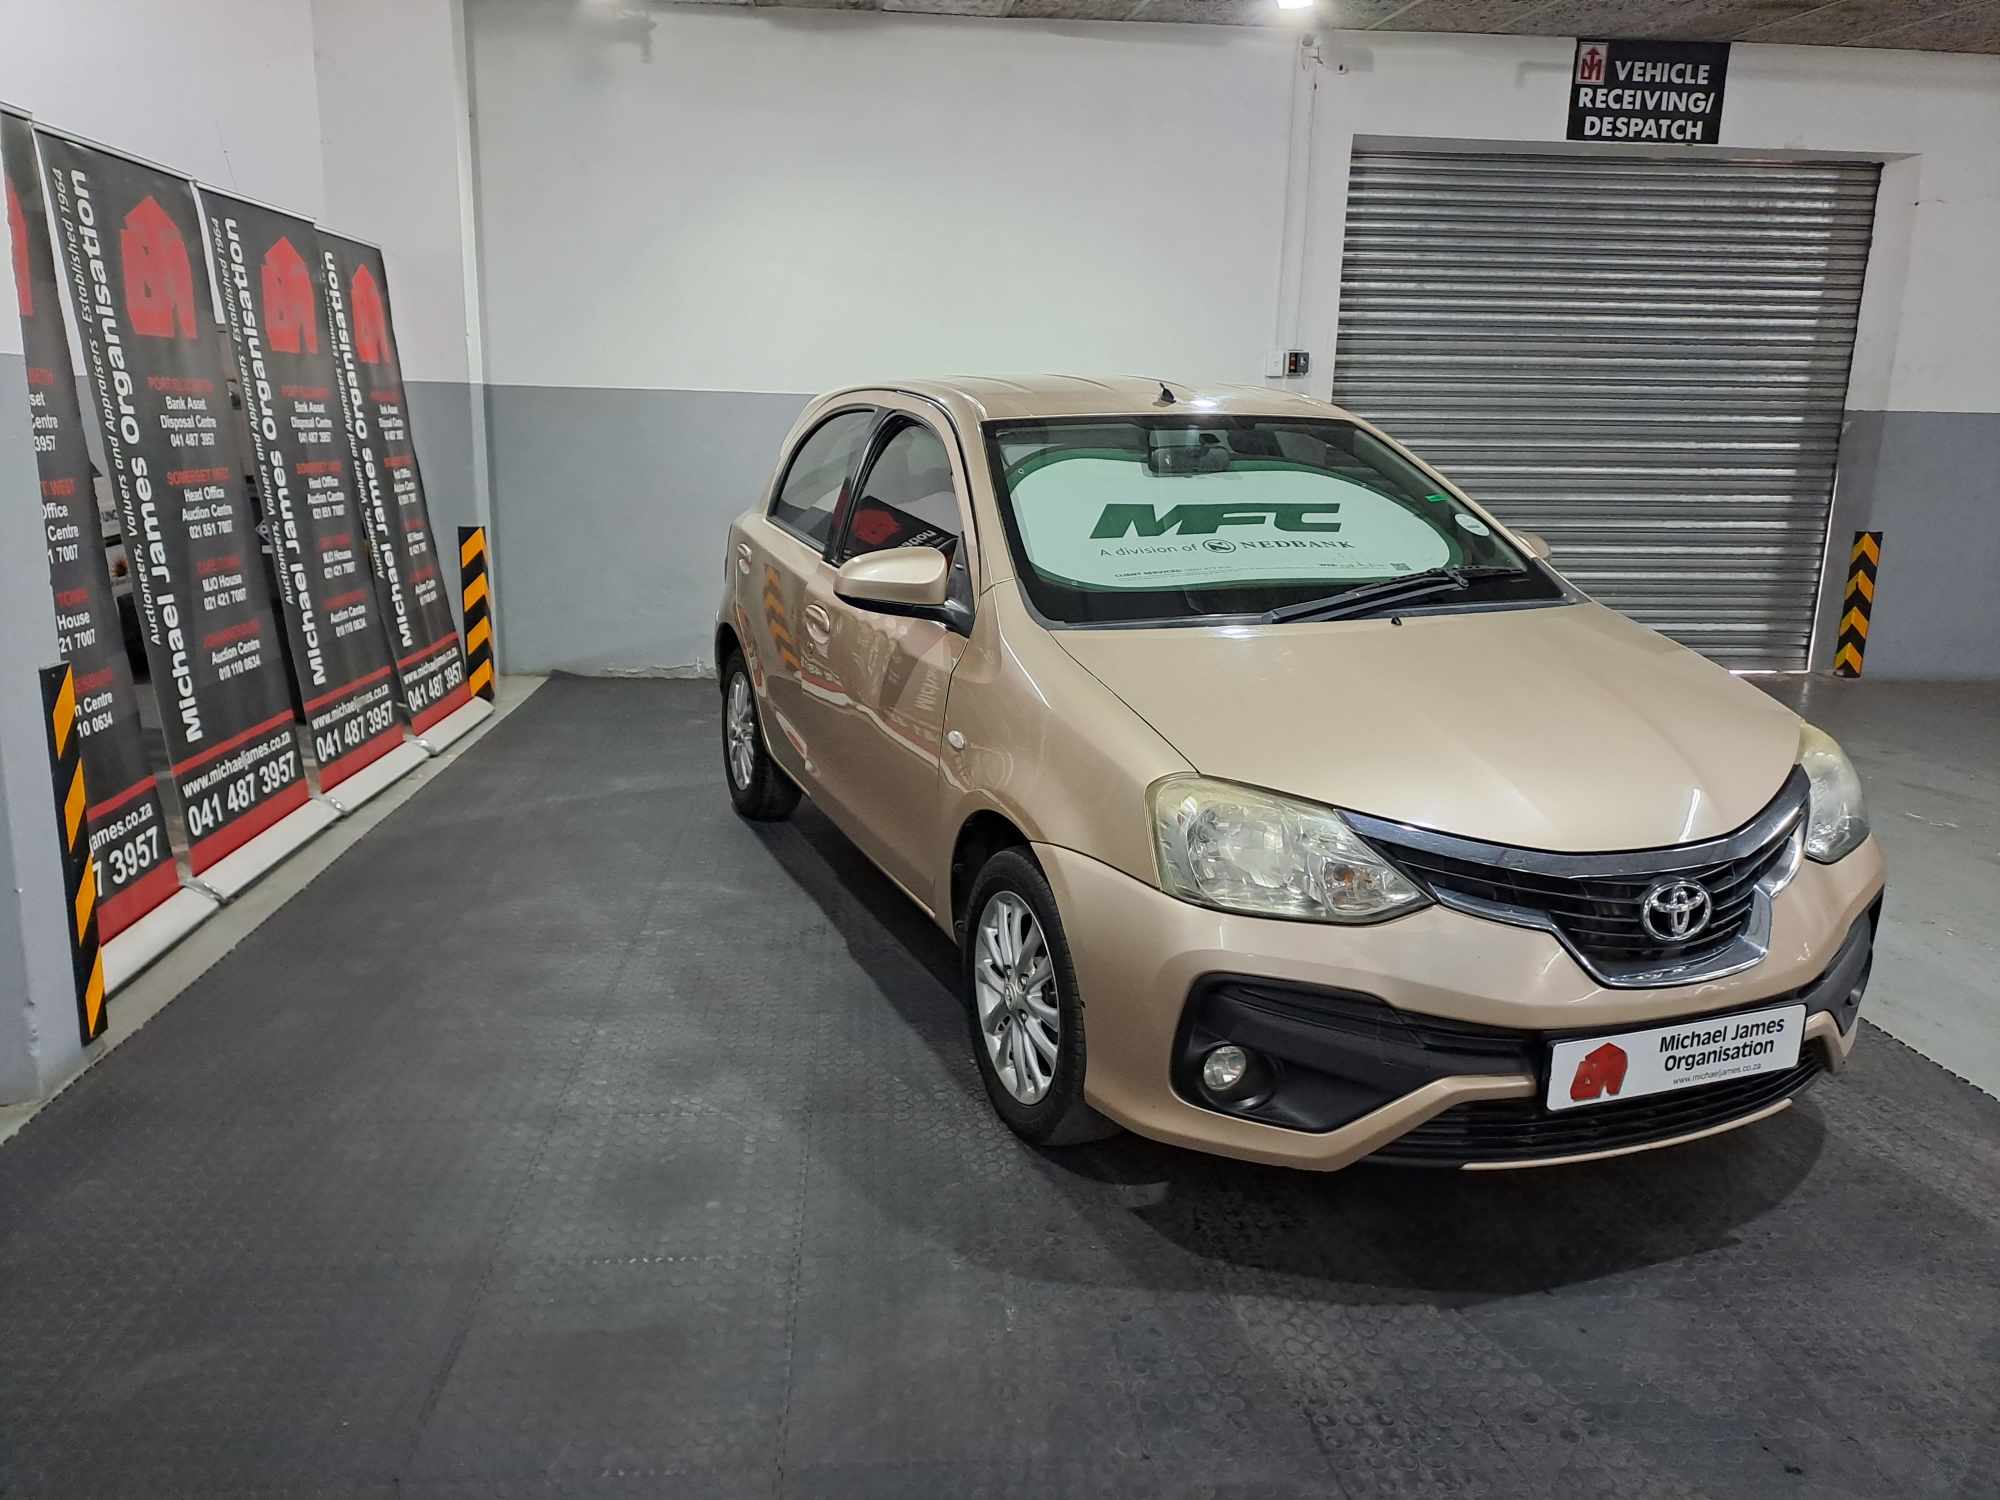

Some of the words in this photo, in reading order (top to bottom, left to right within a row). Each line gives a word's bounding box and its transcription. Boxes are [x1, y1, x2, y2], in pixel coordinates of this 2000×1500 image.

[1615, 60, 1710, 85] VEHICLE
[1578, 87, 1715, 114] RECEIVING/
[1583, 116, 1703, 141] DESPATCH
[52, 168, 71, 214] 1964
[211, 217, 225, 254] 1964
[62, 217, 93, 323] Established
[71, 169, 139, 445] Organisation
[225, 217, 277, 441] Organisation
[324, 251, 368, 440] Organisation
[89, 339, 116, 433] Appraisers
[165, 395, 186, 410] Bank
[238, 354, 260, 431] Appraisers
[160, 414, 195, 432] Disposal
[108, 435, 124, 470] and
[252, 432, 265, 461] and
[346, 432, 358, 458] and
[118, 474, 138, 537] Valuers
[260, 464, 276, 516] Valuers
[270, 450, 300, 554] James
[362, 447, 389, 536] James
[47, 524, 80, 541] Centre
[131, 457, 171, 583] James
[182, 506, 210, 522] Auction
[202, 522, 217, 537] 851
[1089, 502, 1342, 539] MFC
[56, 544, 78, 563] 7007
[1100, 548, 1112, 557] A
[1115, 545, 1178, 556] division
[1181, 543, 1199, 552] of
[1240, 539, 1356, 549] NEDBANK
[134, 543, 161, 646] Auctioneers,
[380, 543, 413, 648] Michael
[56, 612, 91, 631] House
[74, 629, 96, 649] 7007
[290, 563, 327, 686] Michael
[157, 593, 203, 743] Michael
[211, 646, 237, 665] Auction
[83, 692, 113, 713] Centre
[407, 684, 428, 712] 041
[428, 673, 444, 699] 487
[316, 728, 342, 762] 041
[344, 715, 365, 746] 487
[366, 700, 393, 734] 3957
[182, 731, 291, 798] www.michaeljames.co.za
[188, 793, 223, 836] 041
[227, 773, 255, 812] 487
[259, 750, 295, 793] 3957
[109, 825, 158, 884] 3957
[1659, 1025, 1728, 1053] Michael
[1731, 1018, 1785, 1040] James
[1664, 1039, 1774, 1071] Organisation
